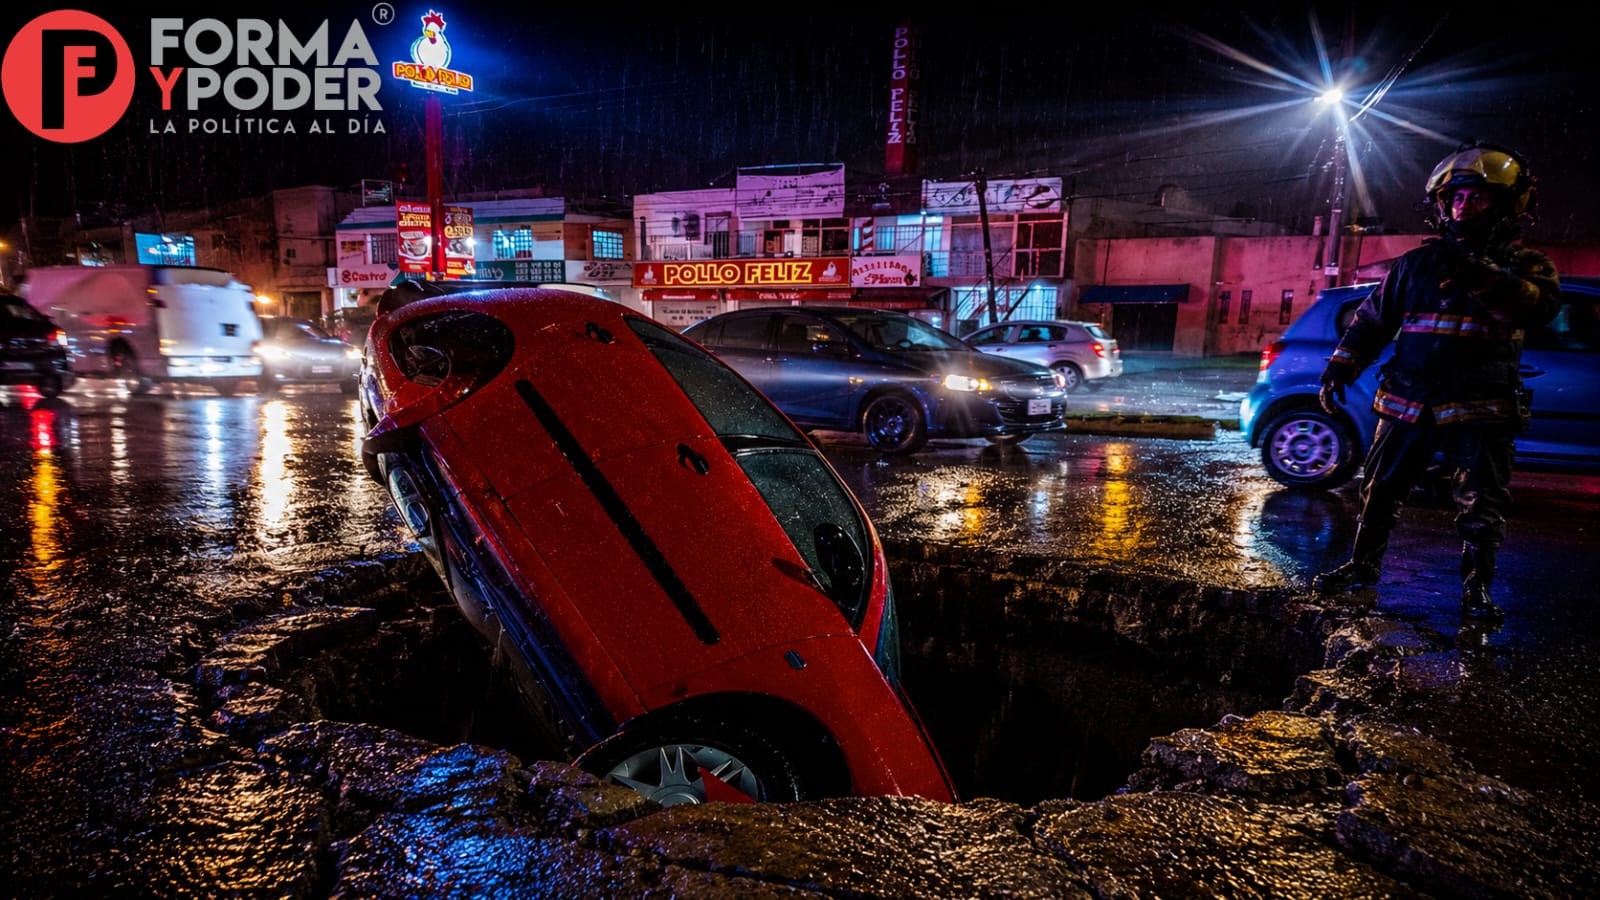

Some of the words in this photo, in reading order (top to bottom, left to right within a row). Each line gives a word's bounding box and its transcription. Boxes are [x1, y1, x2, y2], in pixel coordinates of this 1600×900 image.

[892, 27, 908, 80] POLLO
[664, 264, 741, 284] POLLO
[745, 262, 813, 284] FELIZ
